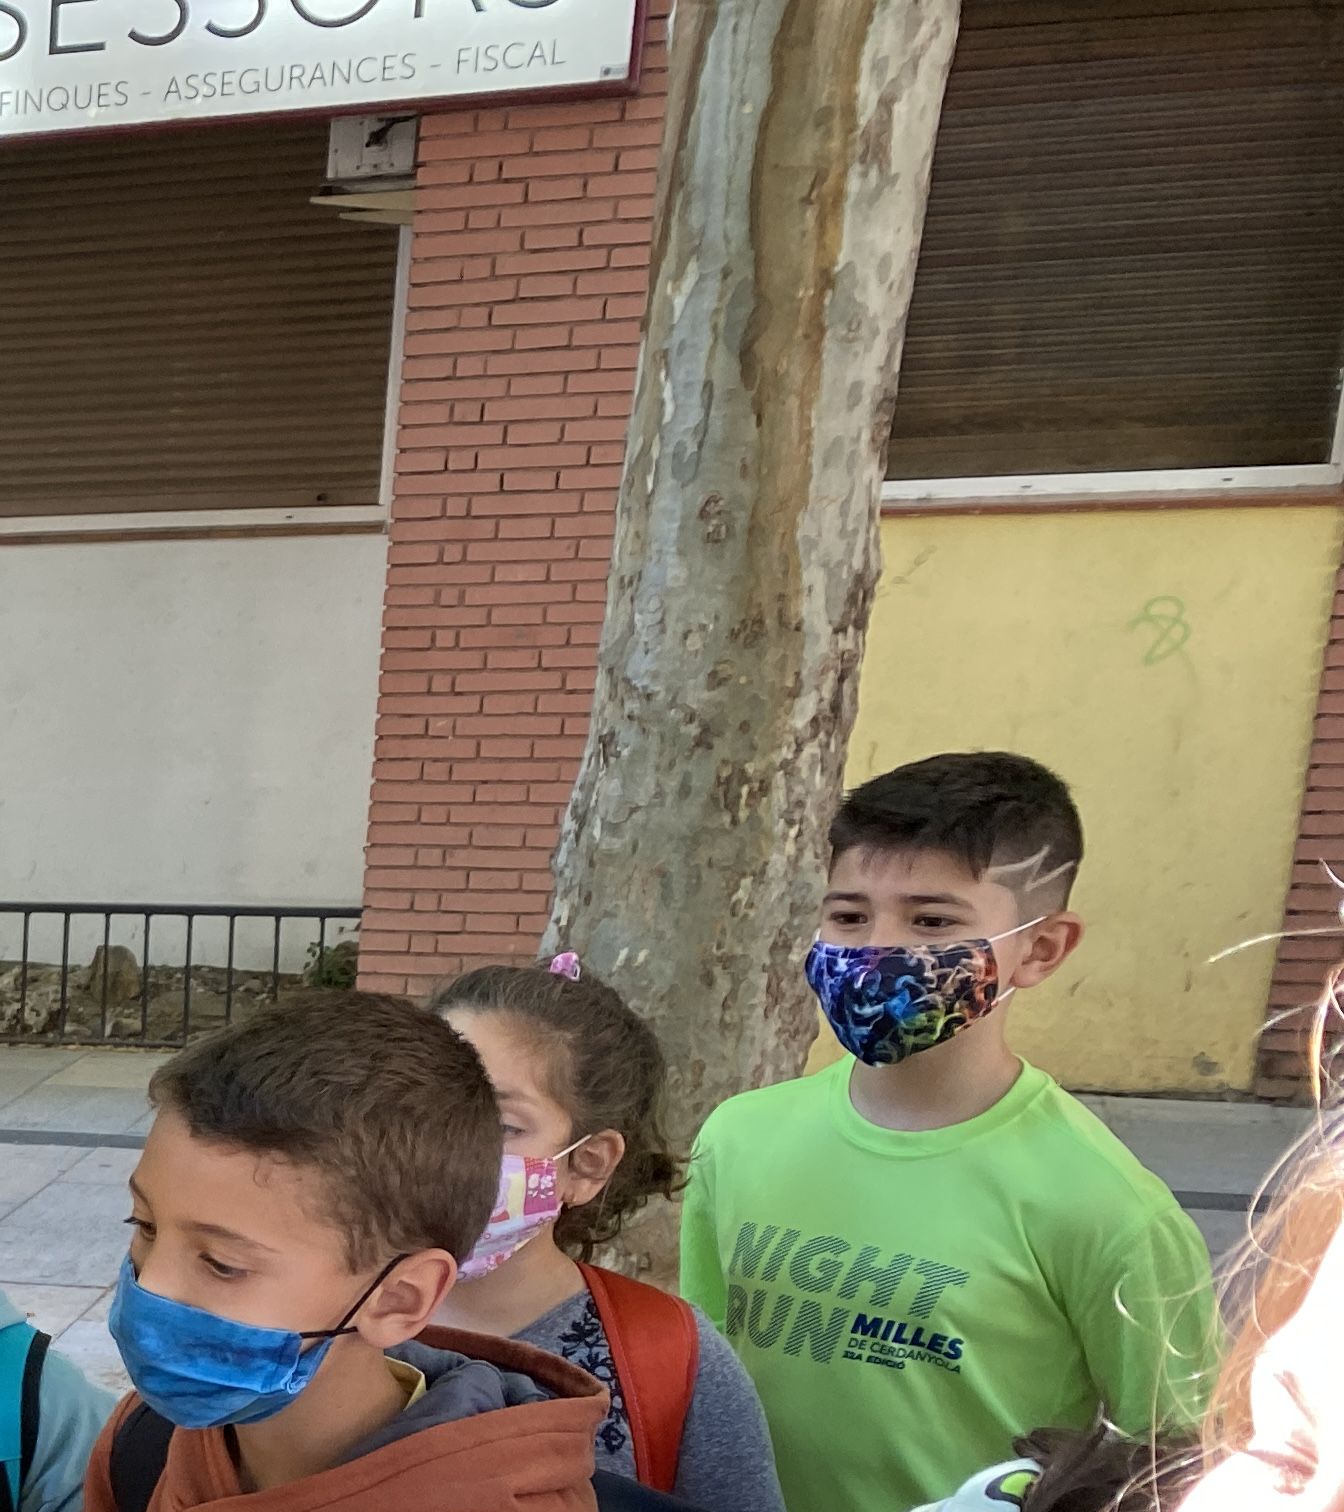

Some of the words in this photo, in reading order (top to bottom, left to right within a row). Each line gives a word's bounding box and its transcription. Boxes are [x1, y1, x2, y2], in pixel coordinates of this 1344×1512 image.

[164, 53, 416, 102] ASSEGURANCES
[455, 38, 566, 75] FISCAL
[728, 1221, 970, 1319] NIGHT
[726, 1284, 850, 1364] RUN
[851, 1313, 965, 1360] MILLES
[847, 1338, 867, 1352] DE
[870, 1342, 961, 1374] CERDANYOLA
[866, 1355, 905, 1370] EDICIÓ
